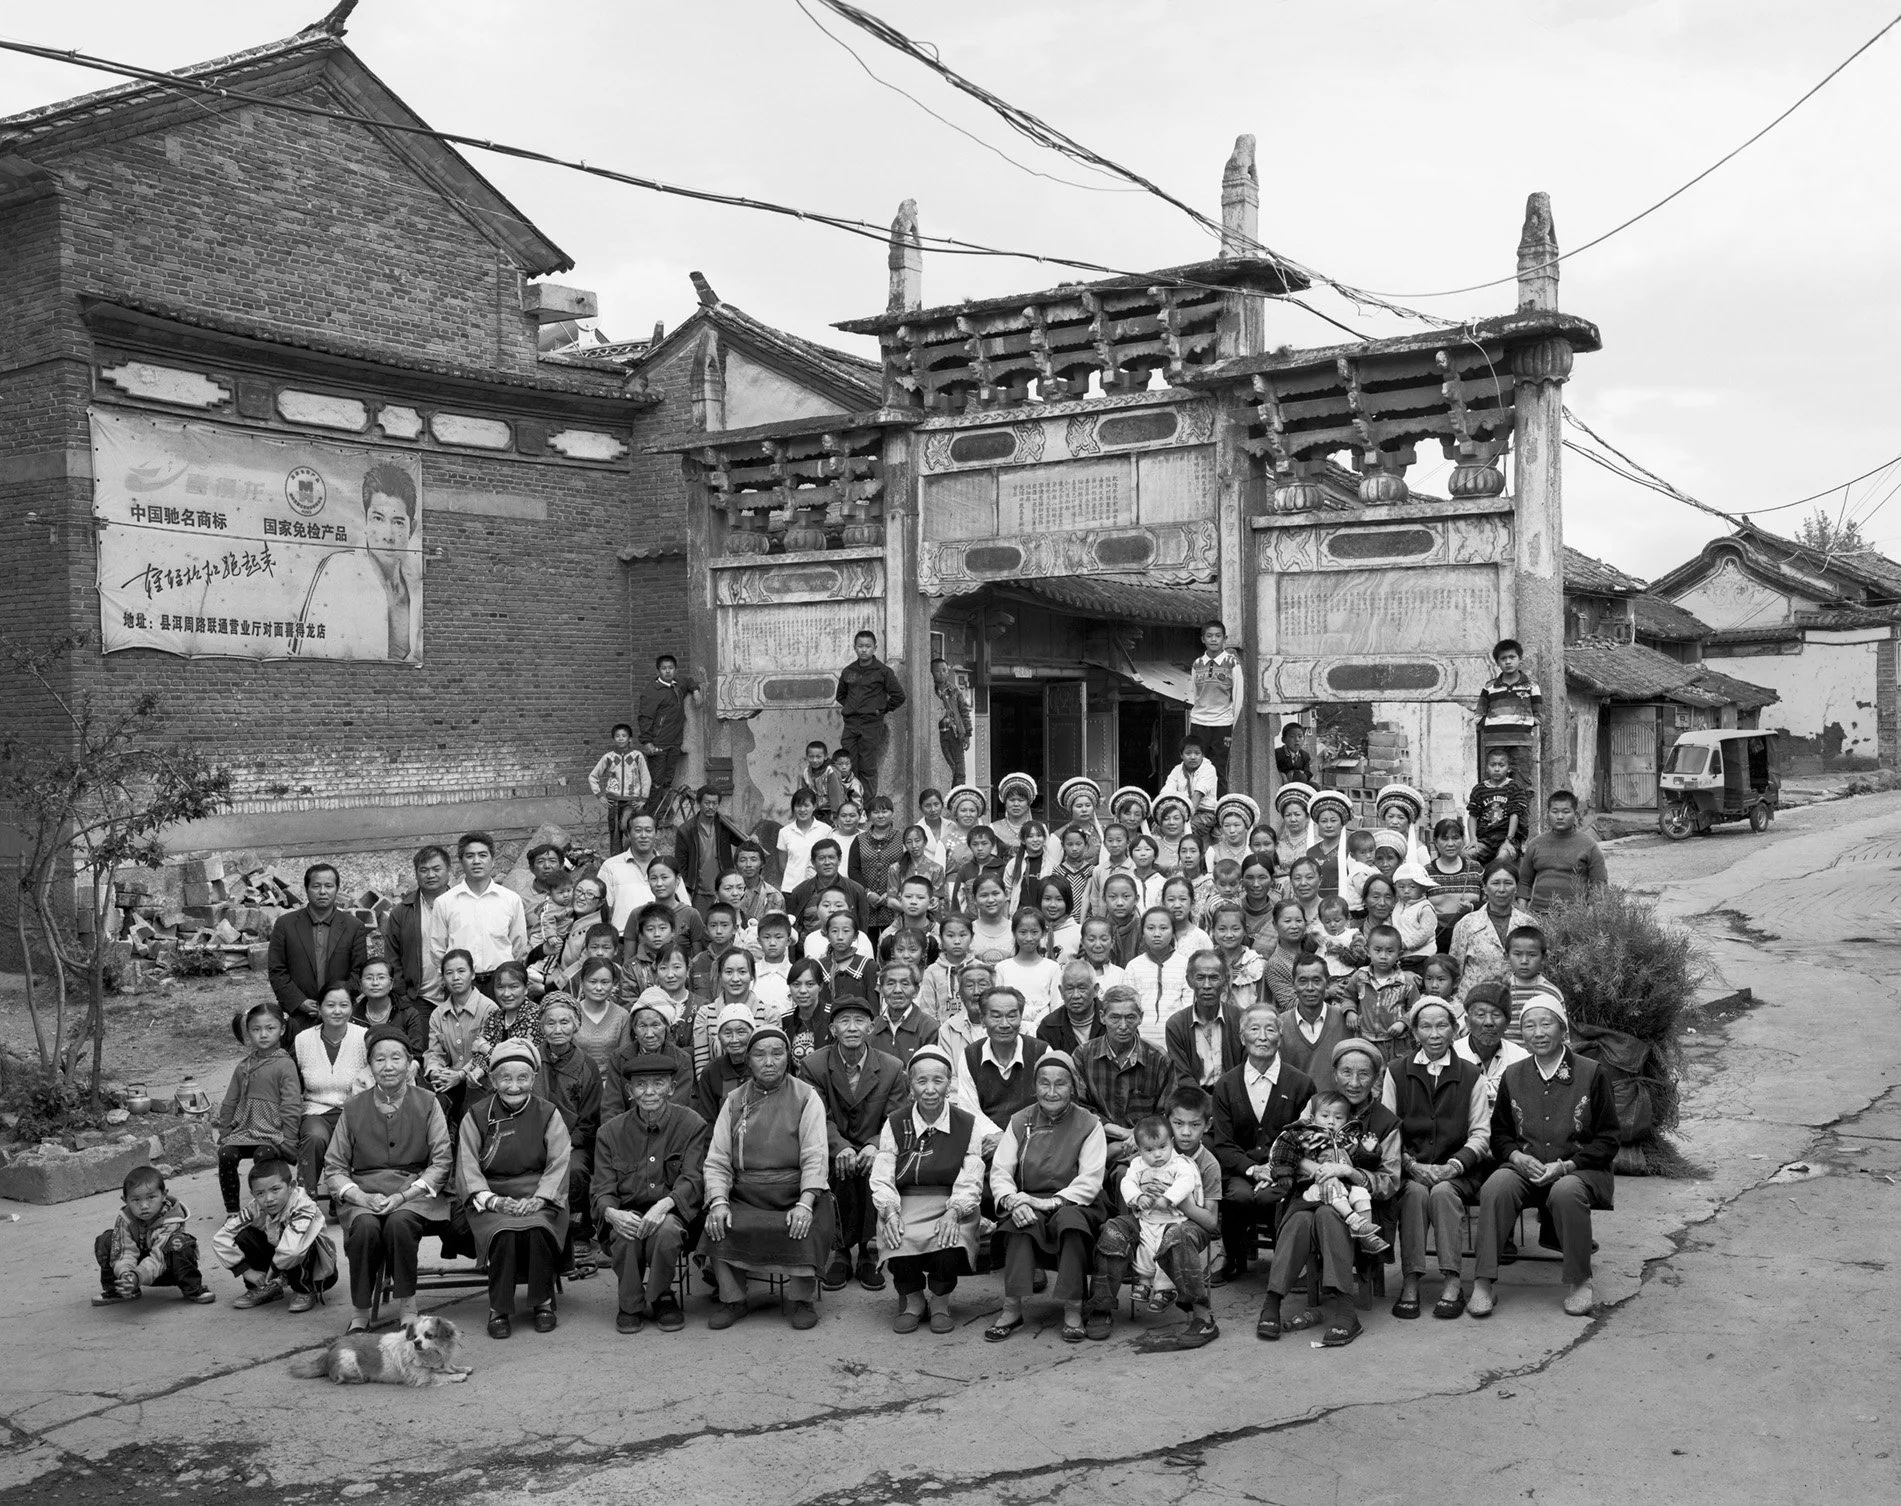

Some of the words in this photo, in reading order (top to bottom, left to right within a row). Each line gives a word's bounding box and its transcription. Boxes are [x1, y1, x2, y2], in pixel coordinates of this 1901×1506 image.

[130, 503, 228, 530] 中国驰名商标
[263, 517, 348, 542] 国家免检产品
